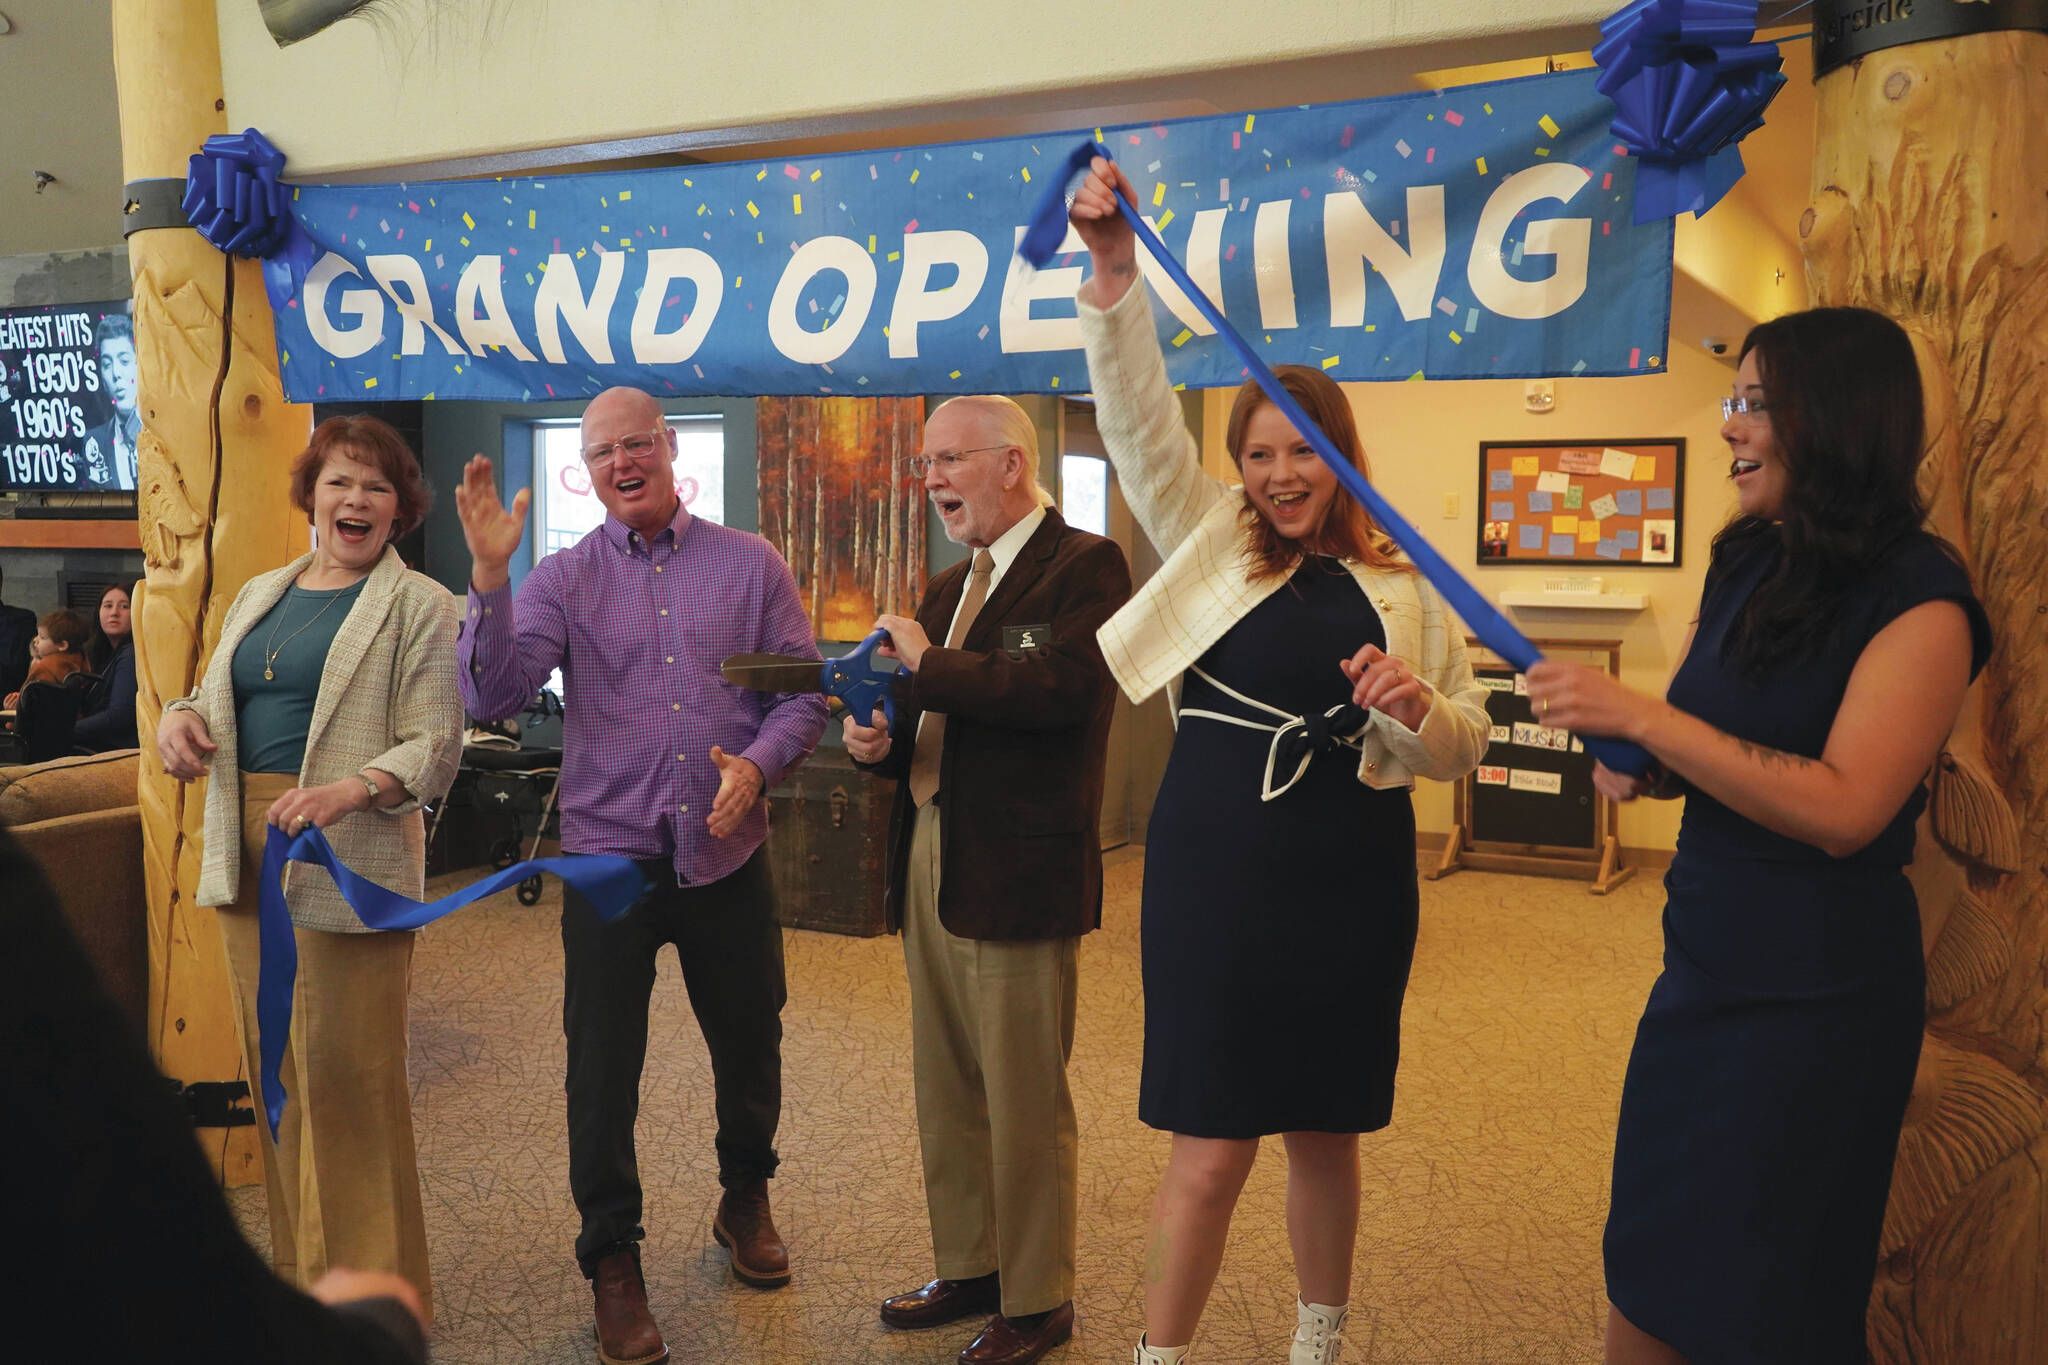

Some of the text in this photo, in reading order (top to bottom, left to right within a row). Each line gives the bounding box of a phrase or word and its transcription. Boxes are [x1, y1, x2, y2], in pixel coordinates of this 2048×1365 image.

[303, 162, 1592, 364] GRAND OPENING
[55, 313, 93, 347] HITS
[22, 351, 100, 394] 1950's
[11, 397, 86, 439] 1960's
[2, 443, 77, 484] 1970's
[1479, 767, 1506, 782] 3:00
